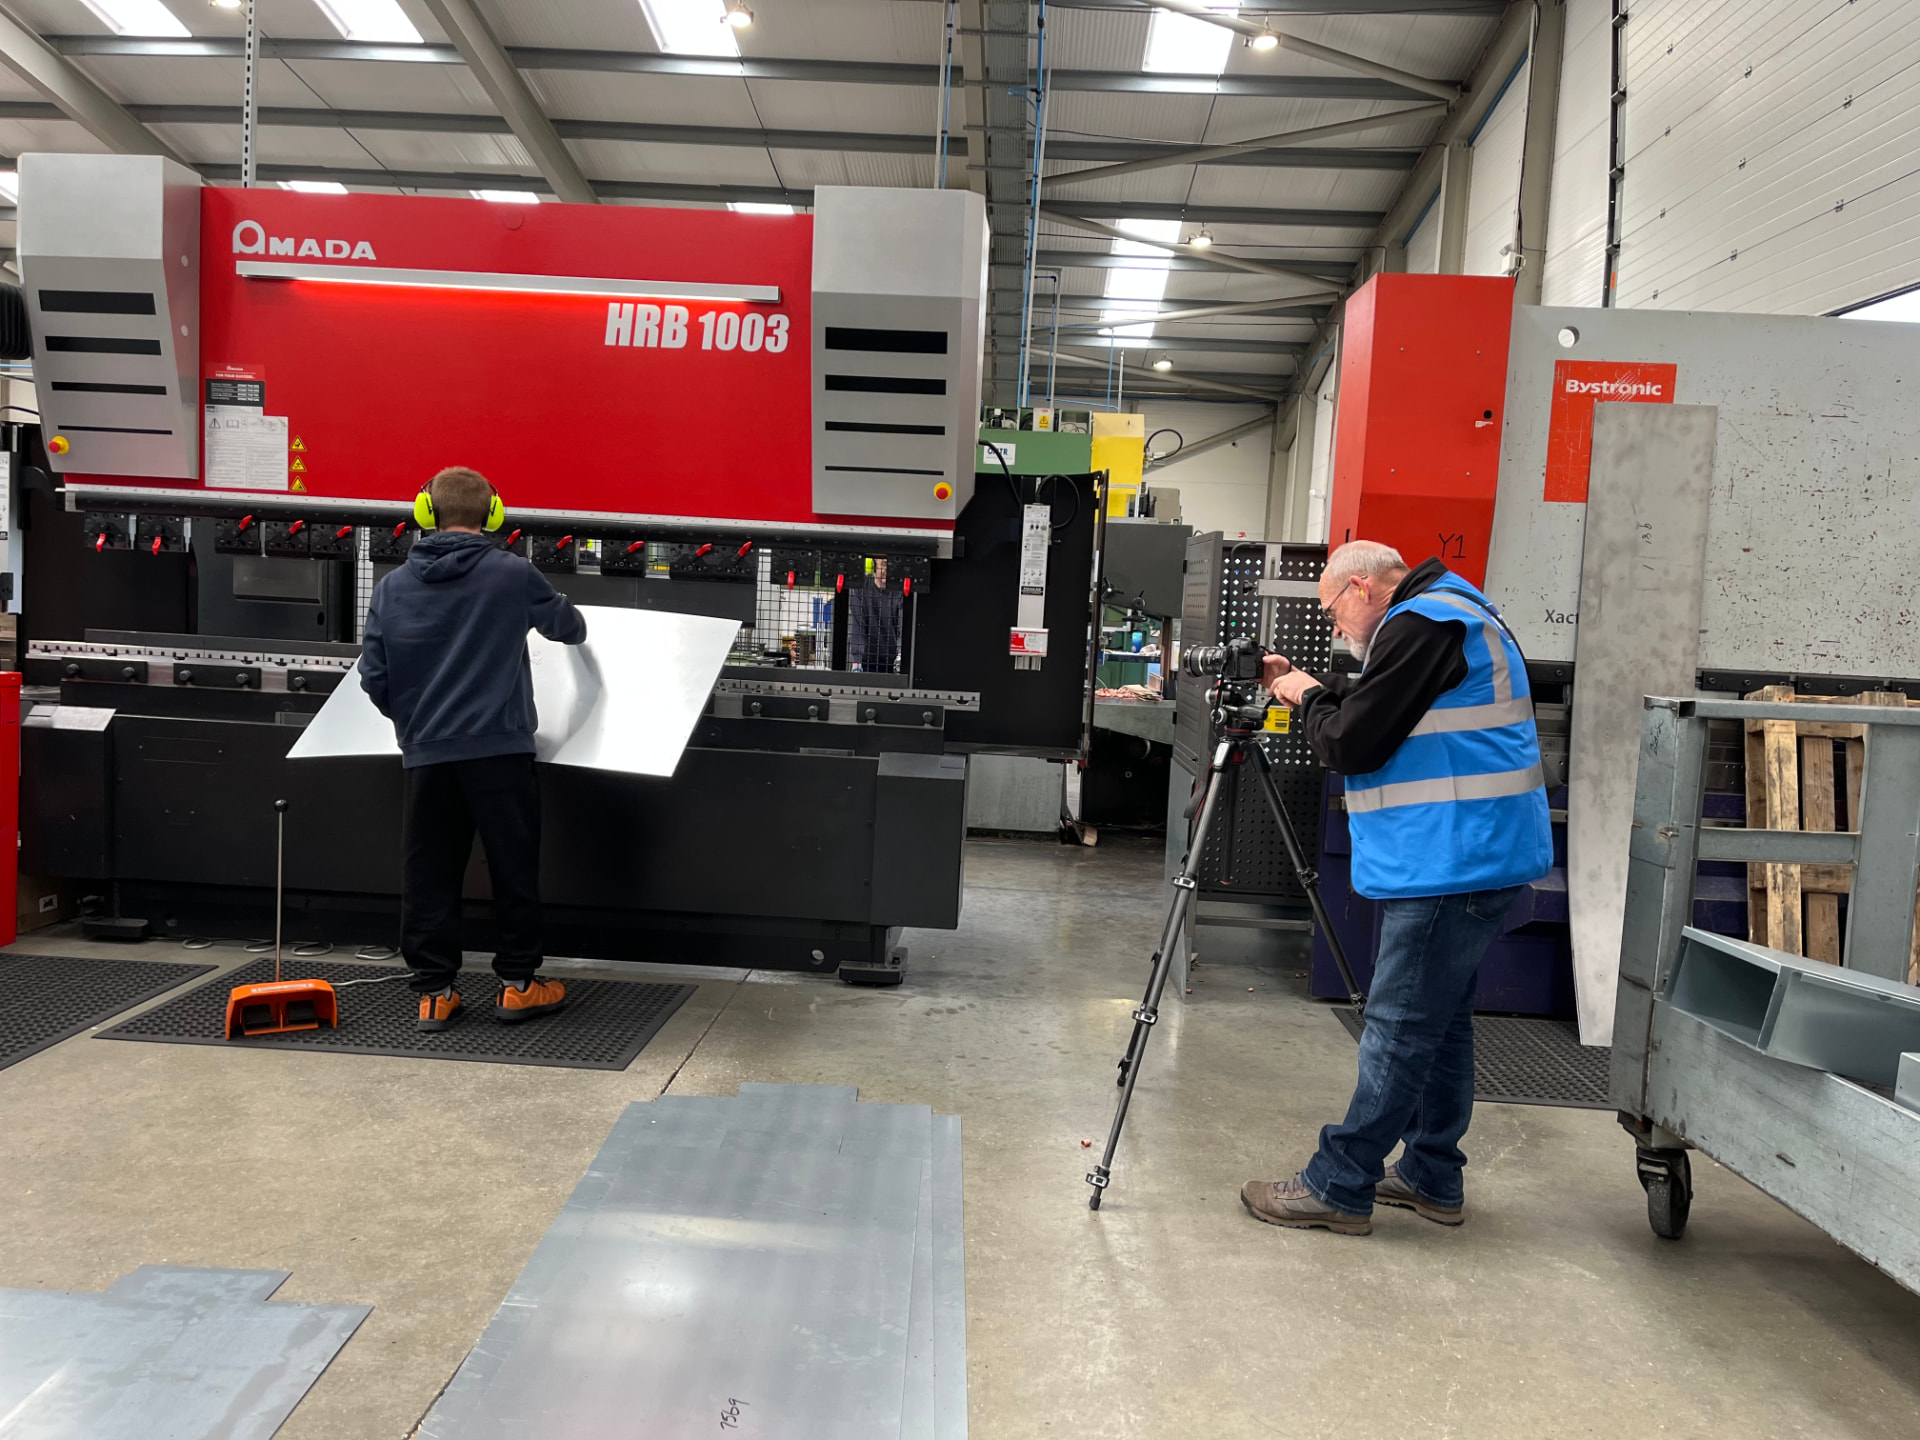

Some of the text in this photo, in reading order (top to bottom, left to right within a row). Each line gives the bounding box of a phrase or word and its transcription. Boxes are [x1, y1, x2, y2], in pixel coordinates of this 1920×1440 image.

[232, 219, 377, 260] AMADA
[604, 302, 790, 353] HRB 1003
[1565, 379, 1662, 396] Bystronic
[1438, 533, 1467, 559] Y1
[720, 1397, 751, 1430] 7569
